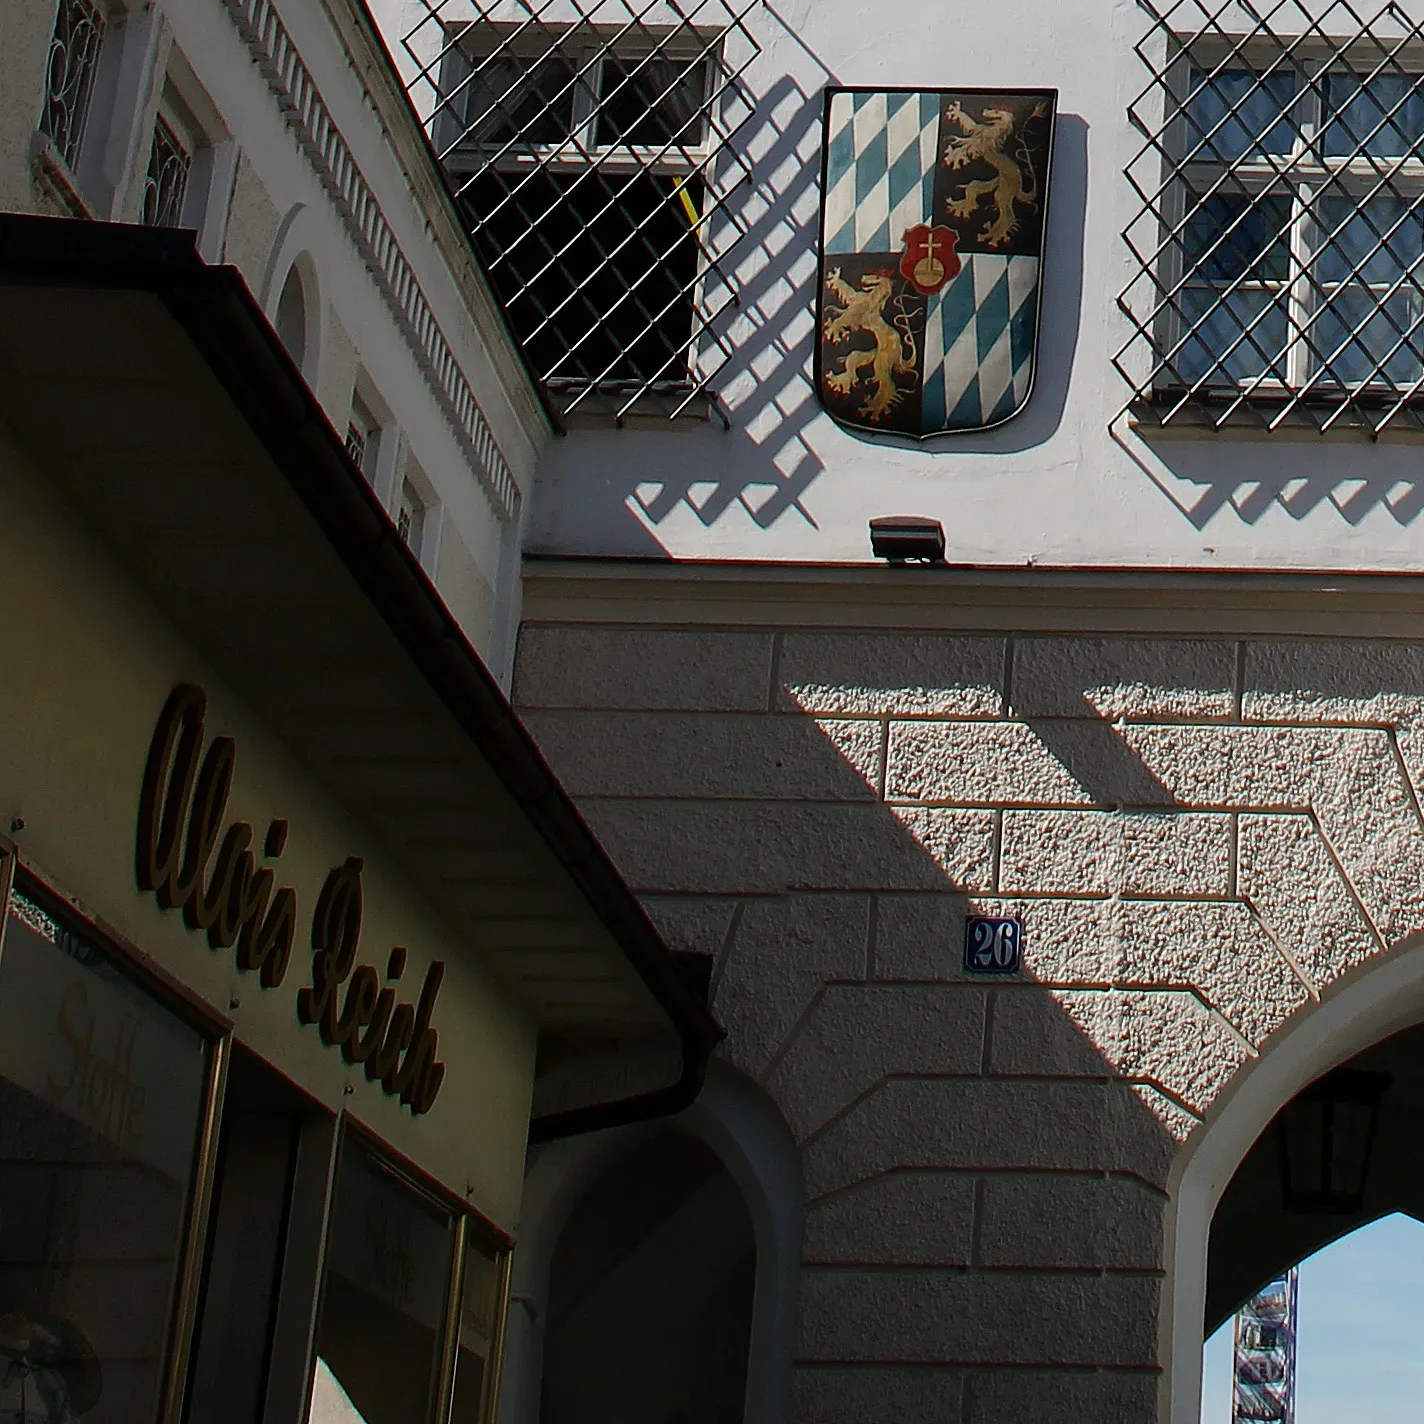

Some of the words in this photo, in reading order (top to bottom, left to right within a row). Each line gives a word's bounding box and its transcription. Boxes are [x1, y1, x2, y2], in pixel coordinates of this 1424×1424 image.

[136, 683, 296, 988] Alois
[298, 856, 446, 1115] Reich
[974, 922, 1013, 966] 26
